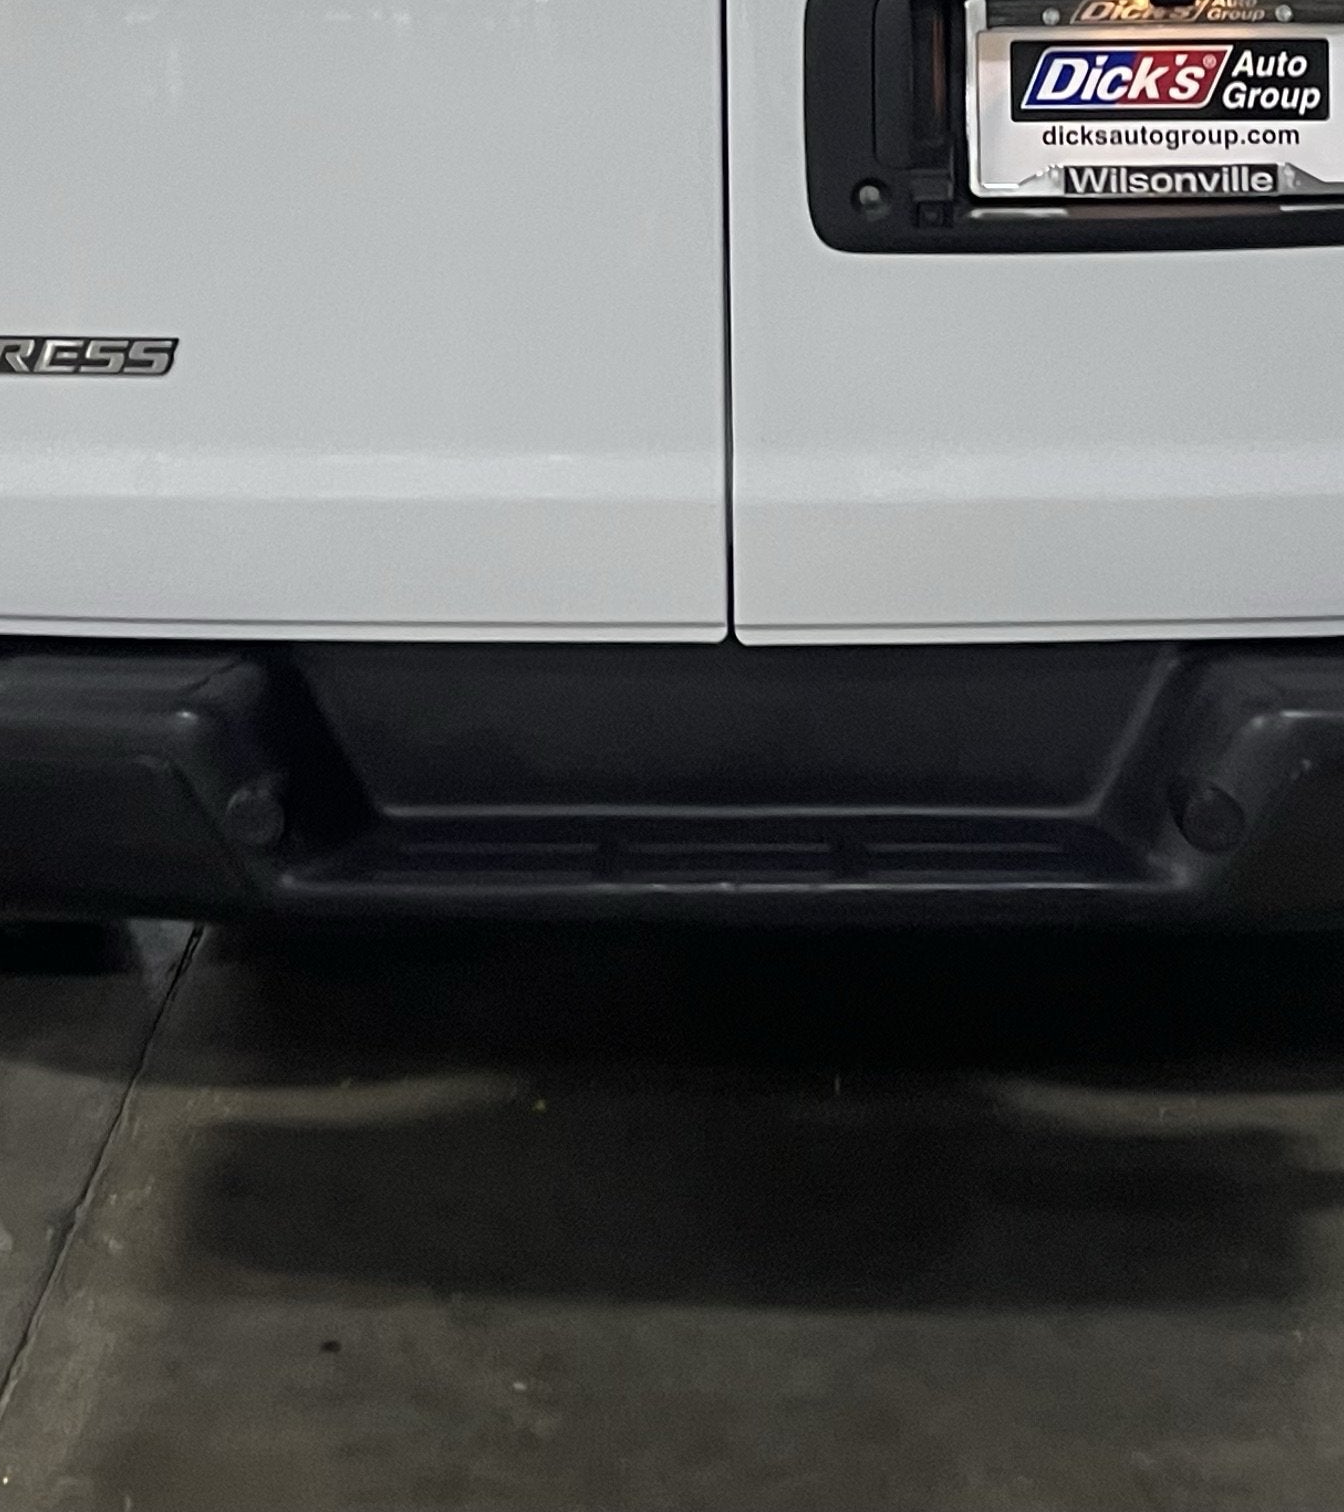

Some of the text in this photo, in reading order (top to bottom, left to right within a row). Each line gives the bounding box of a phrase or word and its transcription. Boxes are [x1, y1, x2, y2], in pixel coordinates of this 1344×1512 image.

[1207, 7, 1266, 22] Group
[1036, 54, 1206, 101] Dick's
[1231, 50, 1308, 78] Auto
[1222, 81, 1322, 115] Group
[1042, 125, 1300, 150] dicksautogroup.com
[1068, 166, 1274, 194] Wilsonville
